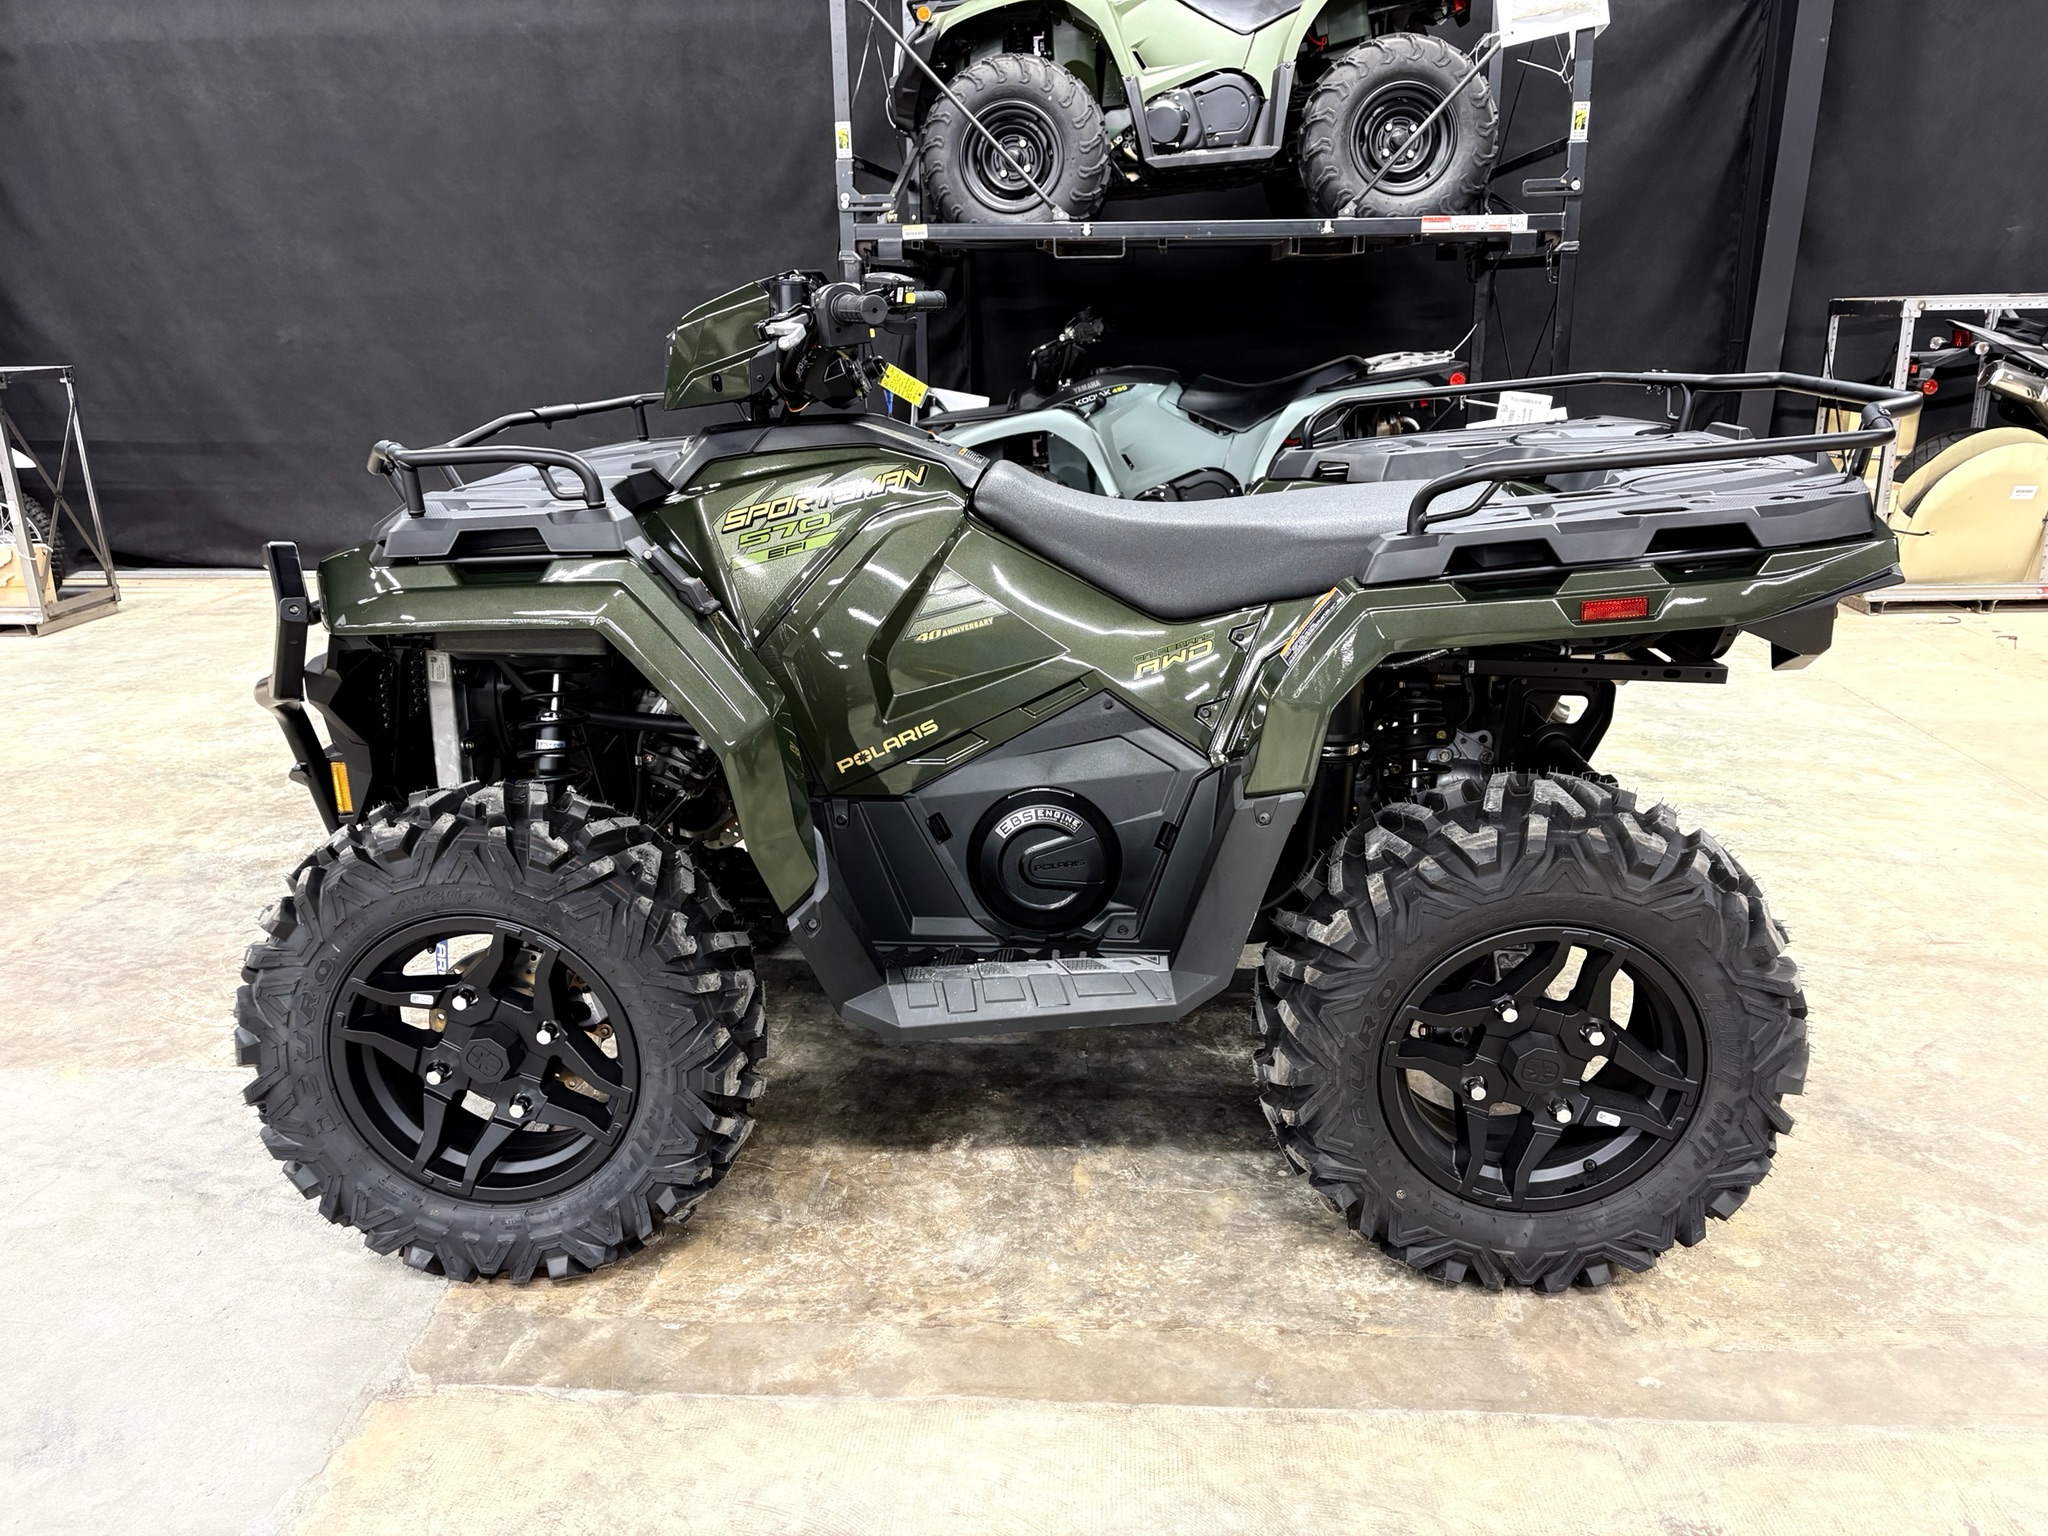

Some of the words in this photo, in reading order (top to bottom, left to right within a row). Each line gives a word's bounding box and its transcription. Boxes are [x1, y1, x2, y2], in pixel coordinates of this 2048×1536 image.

[1073, 380, 1101, 393] YAMAHA
[1112, 384, 1128, 393] 450
[721, 464, 929, 534] SPORTSMAN
[738, 512, 832, 548] 570
[767, 541, 807, 559] EFI
[914, 628, 942, 642] 40
[942, 617, 994, 637] ANNIVERSARY
[1134, 639, 1214, 680] AWD
[836, 719, 938, 774] POLARIS
[999, 810, 1034, 835] EBS
[1037, 809, 1080, 828] ENGINE
[1034, 860, 1085, 872] POLARIS
[1350, 977, 1400, 1131] DURO
